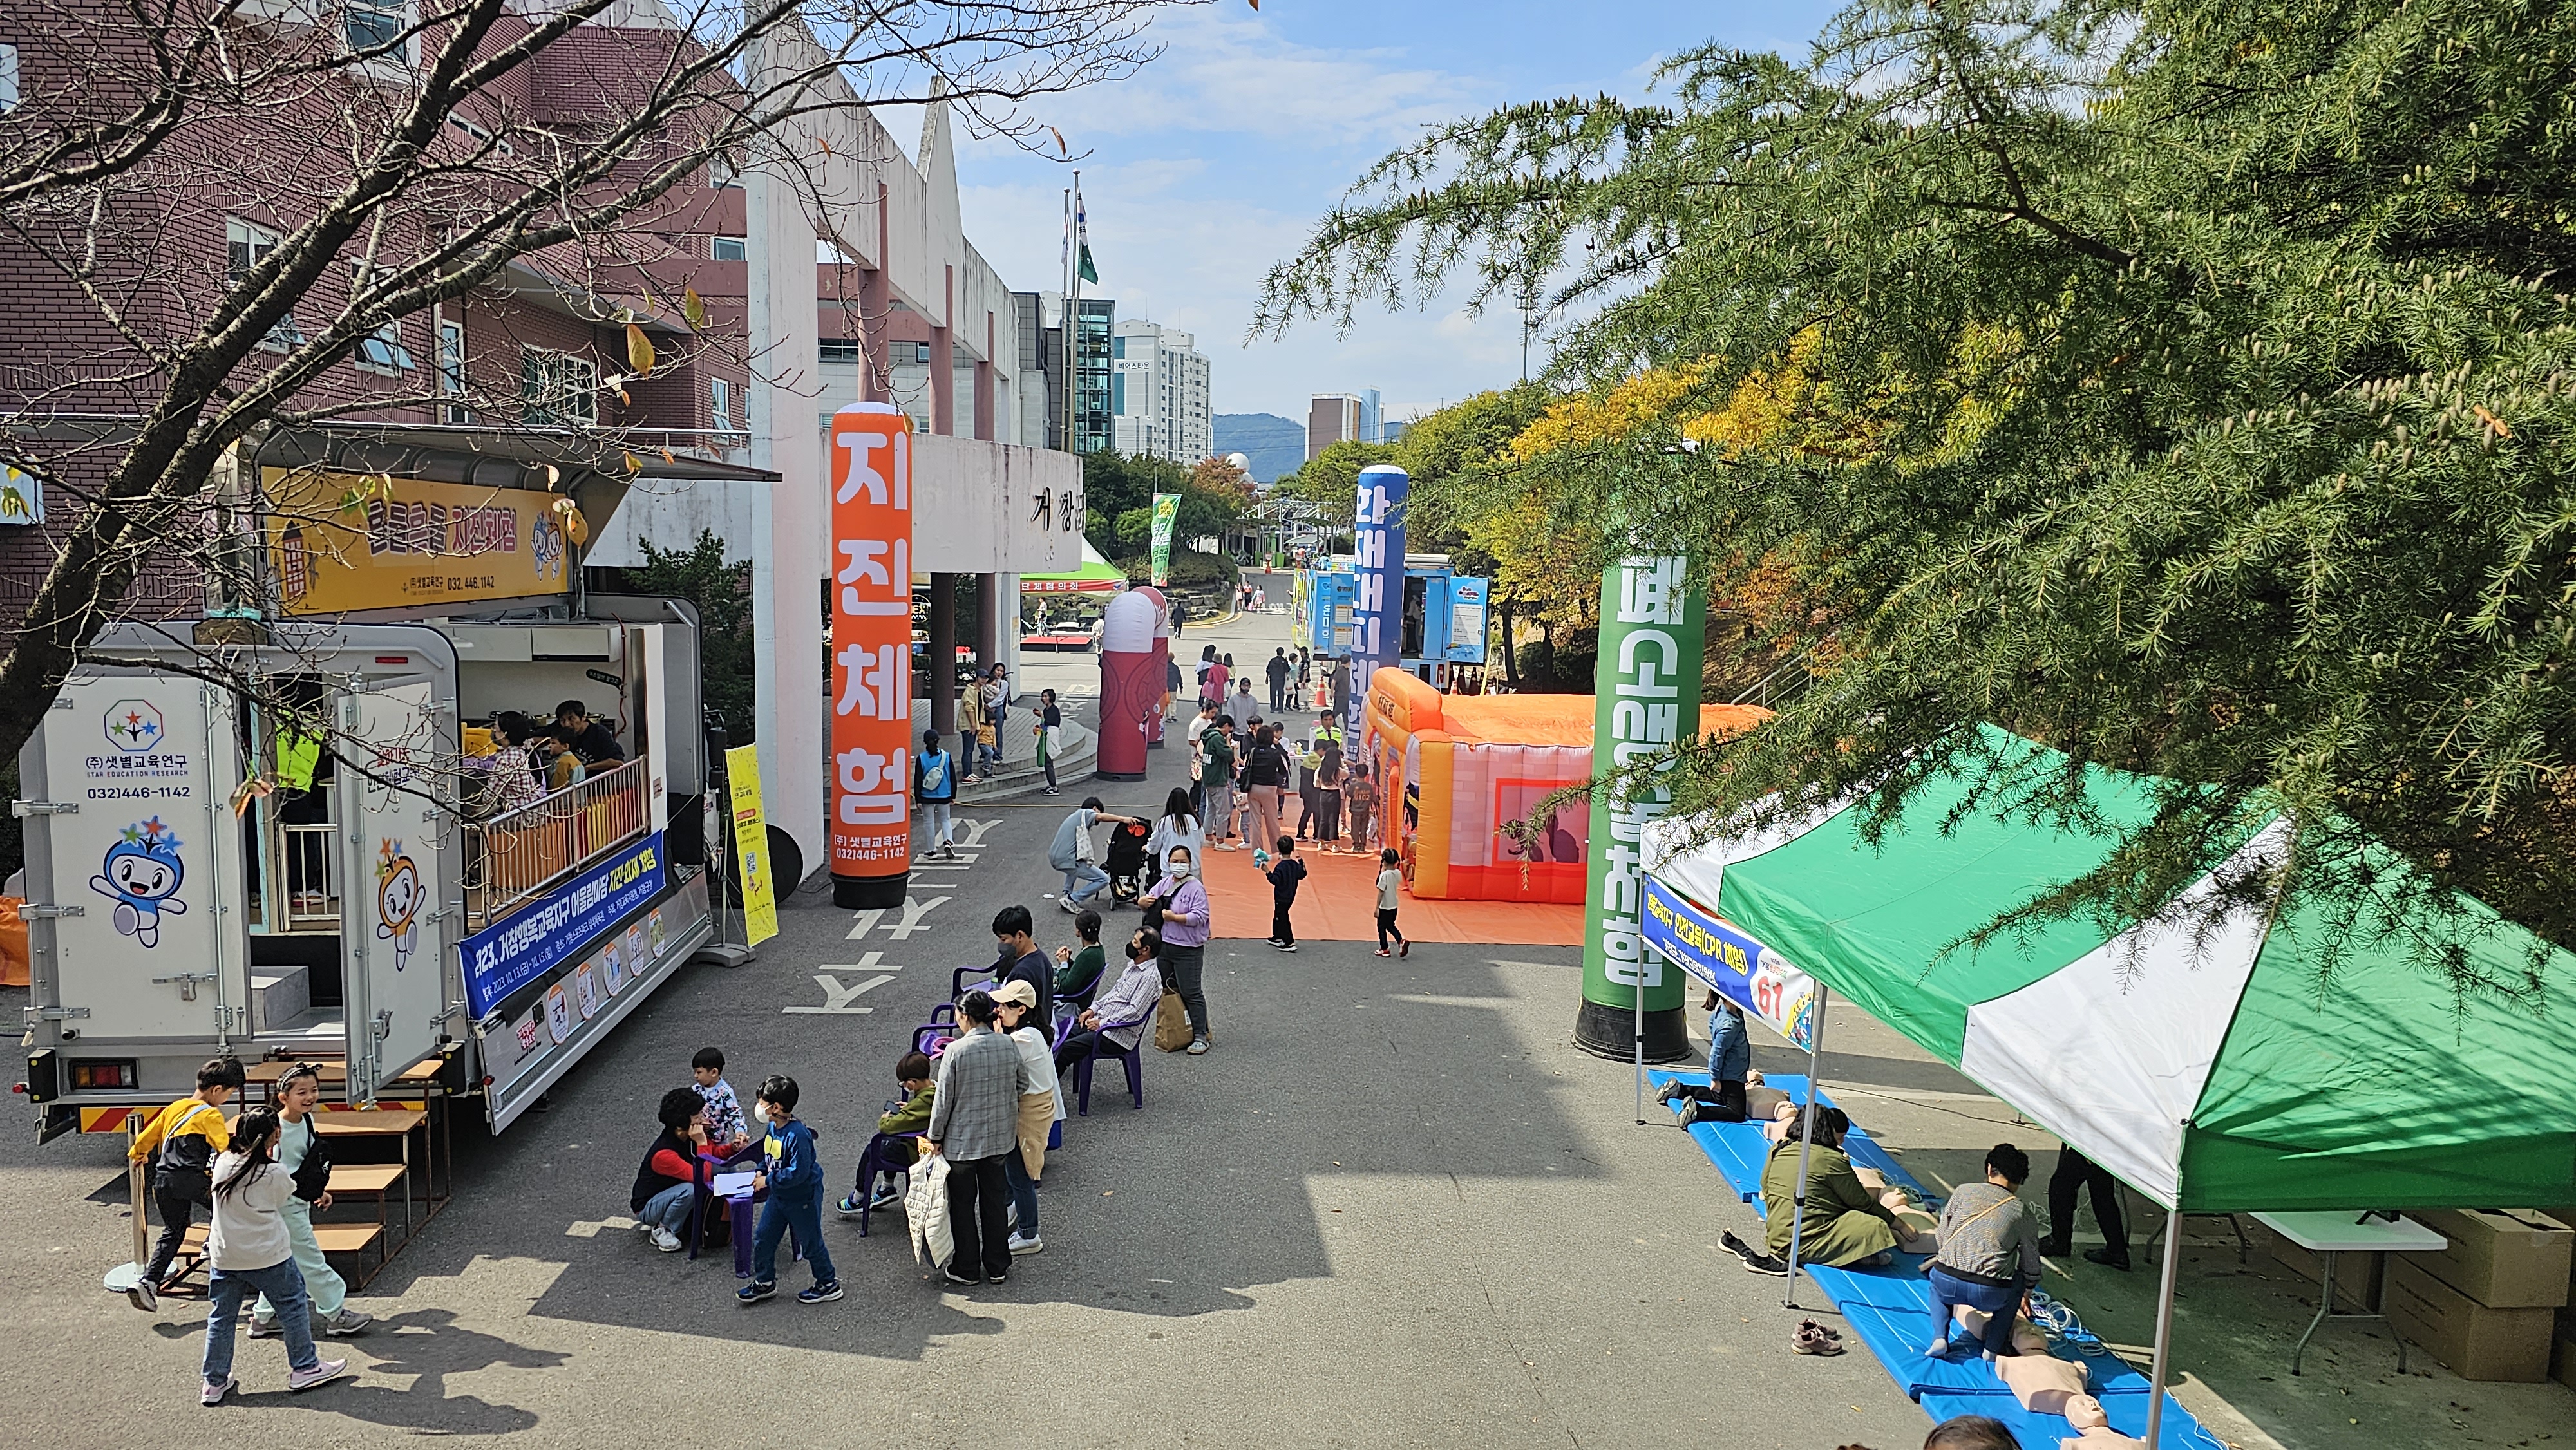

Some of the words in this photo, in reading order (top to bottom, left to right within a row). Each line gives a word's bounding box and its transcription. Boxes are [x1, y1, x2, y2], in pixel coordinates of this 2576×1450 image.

[452, 506, 516, 554] 지진체험
[837, 431, 908, 825] 지진체험
[88, 787, 191, 799] 032)446-1142
[837, 846, 904, 860] 032)446-1142
[849, 833, 907, 848] 샛별교육연구
[498, 896, 570, 963] 거창행복교육지구
[571, 872, 609, 918] 어울림마당
[1757, 975, 1783, 1021] 61
